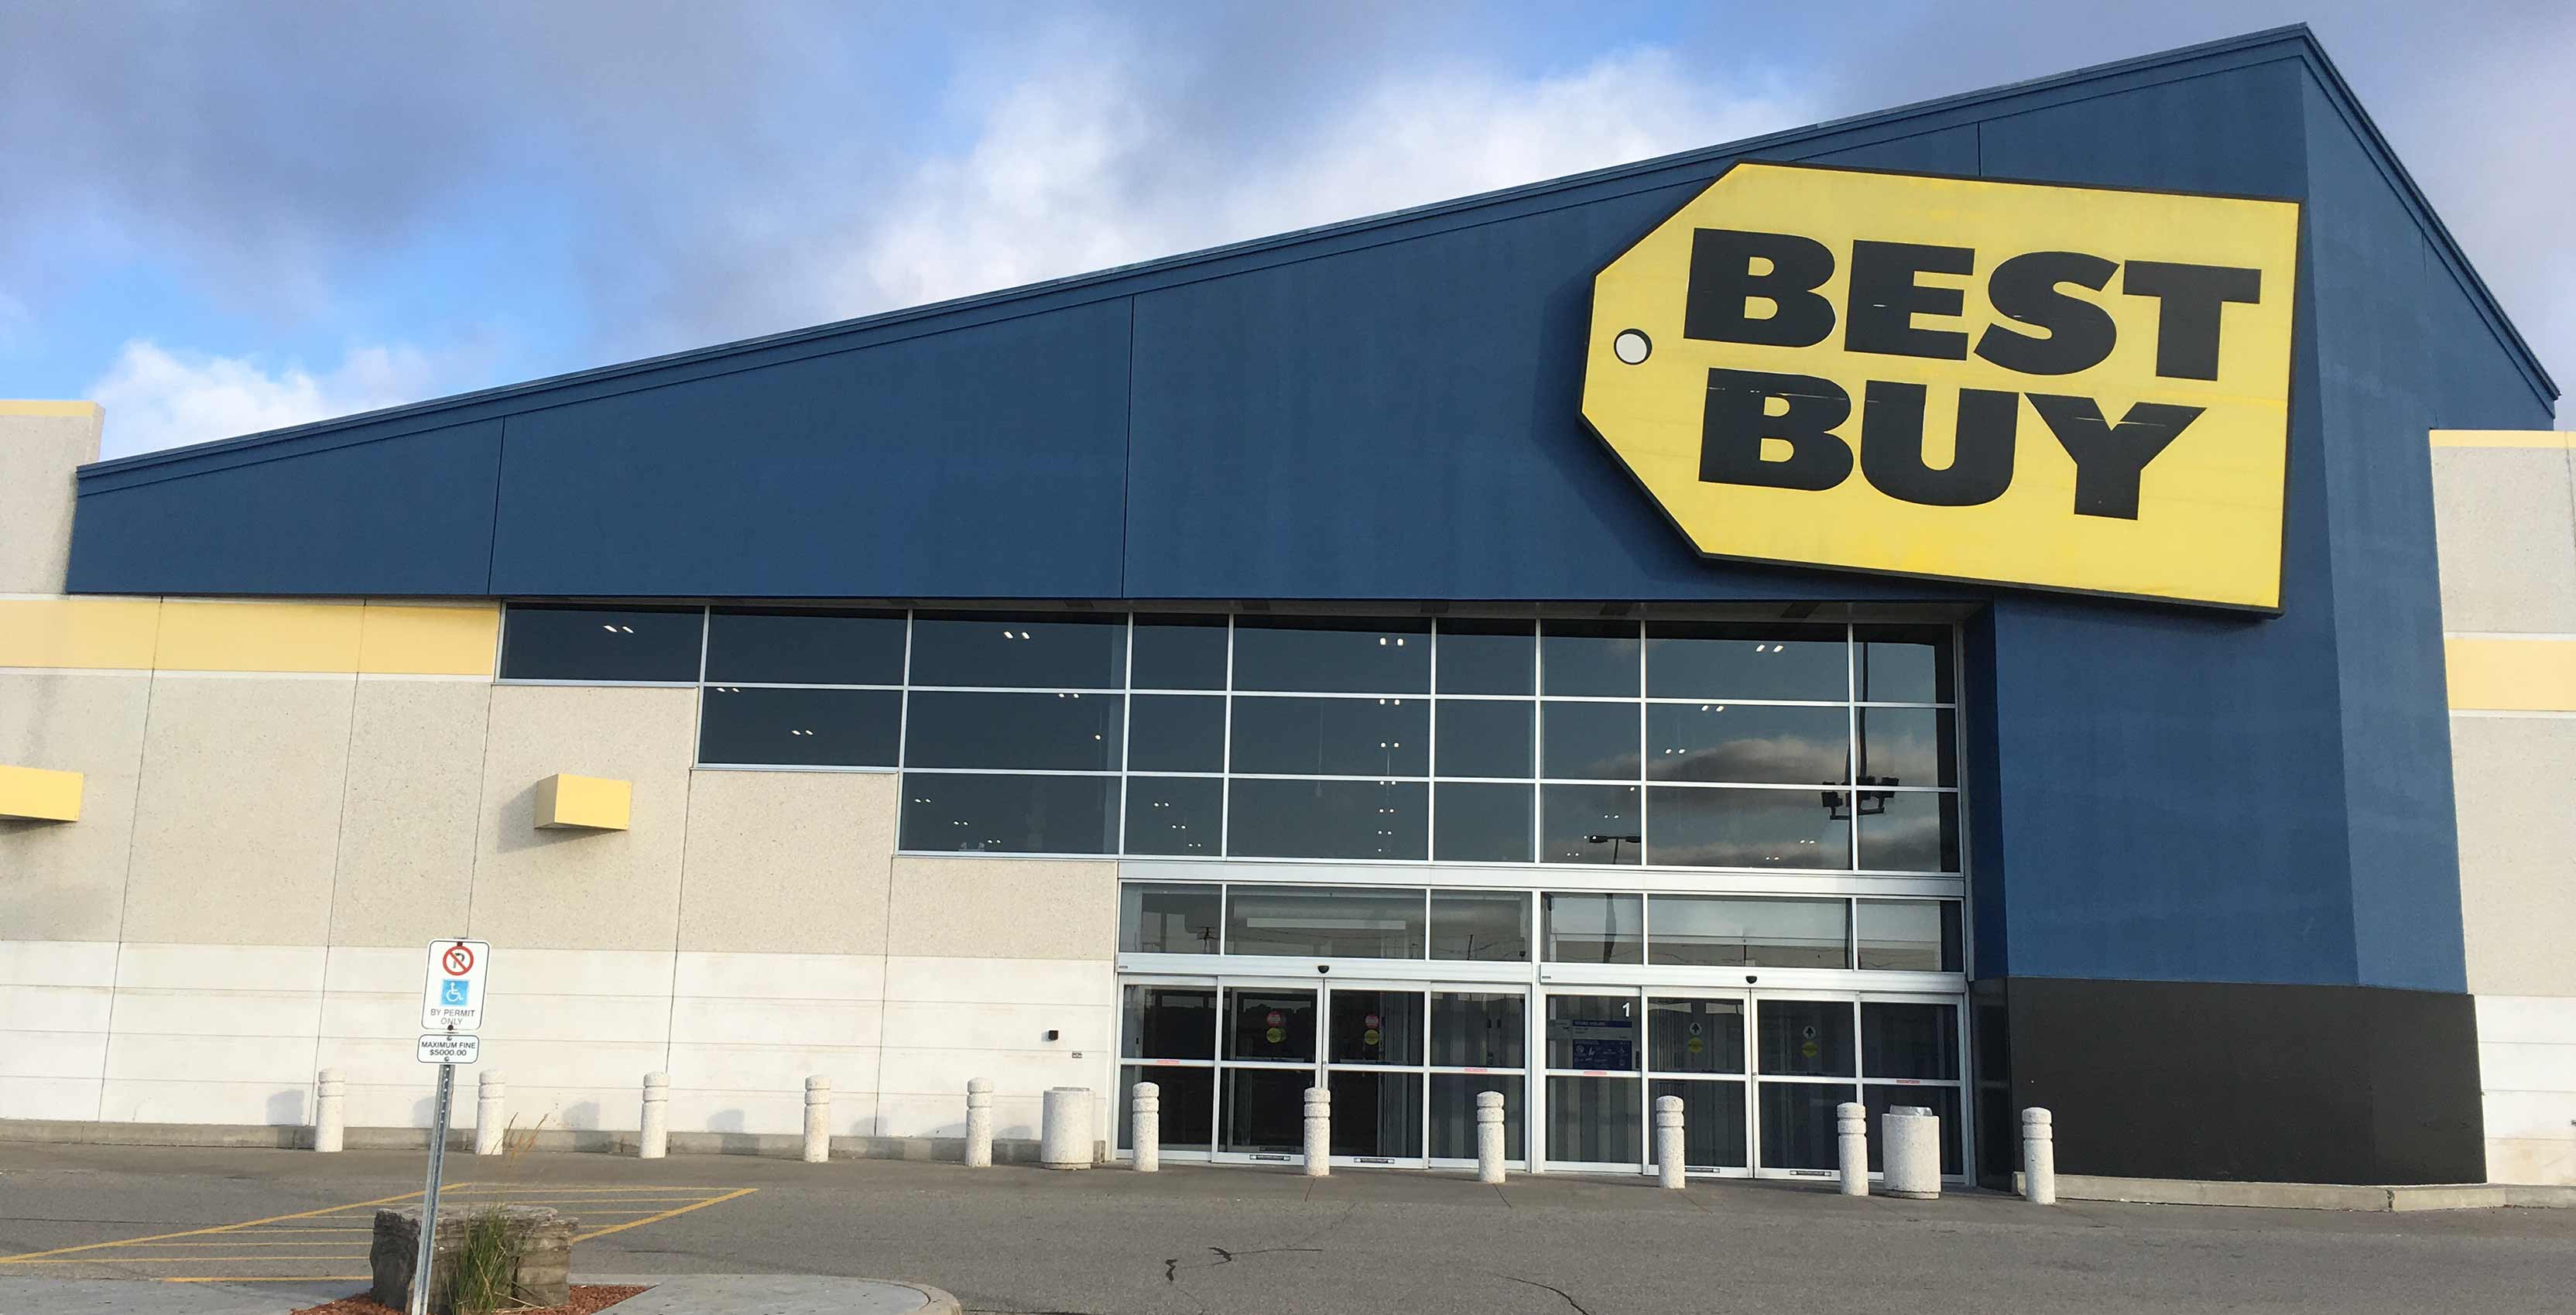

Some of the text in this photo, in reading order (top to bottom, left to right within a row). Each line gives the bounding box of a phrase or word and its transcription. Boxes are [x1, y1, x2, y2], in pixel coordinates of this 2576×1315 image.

[1683, 227, 2262, 382] BEST
[1697, 367, 2207, 521] BUY
[444, 1009, 475, 1017] PERMIT
[1622, 1002, 1630, 1018] 1
[440, 1017, 463, 1026] ONLY
